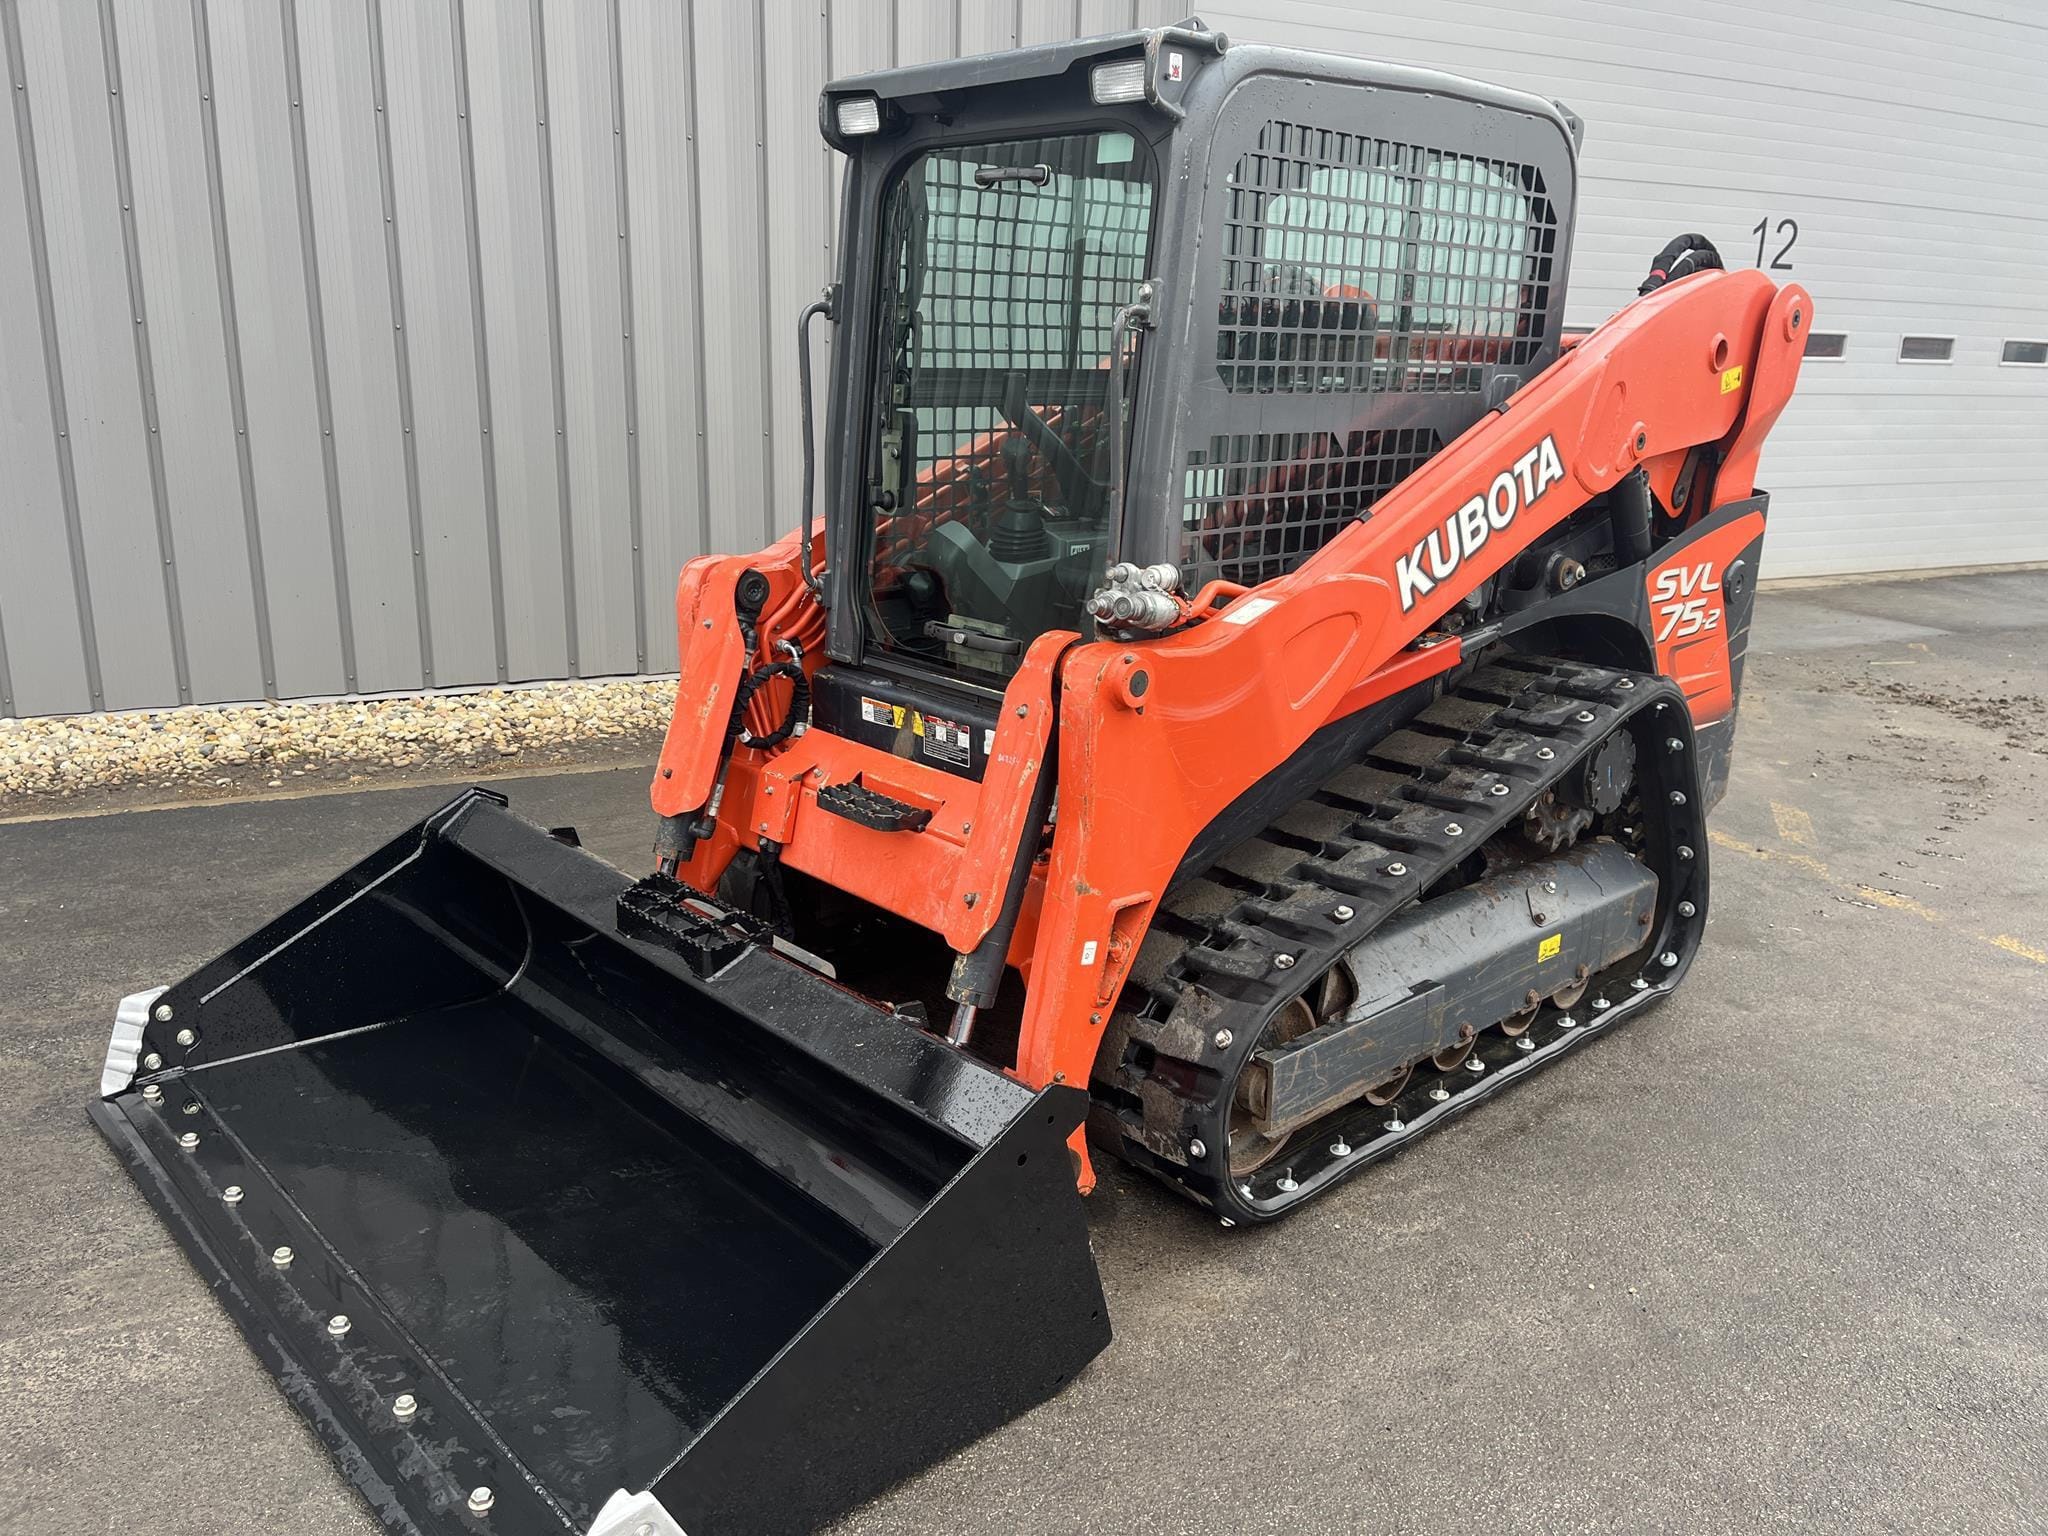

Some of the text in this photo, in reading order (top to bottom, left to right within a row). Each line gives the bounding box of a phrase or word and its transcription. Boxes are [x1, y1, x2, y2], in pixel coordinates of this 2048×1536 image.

[1752, 216, 1799, 270] 12
[1395, 435, 1564, 612] KUBOTA
[1652, 562, 1720, 603] SVL
